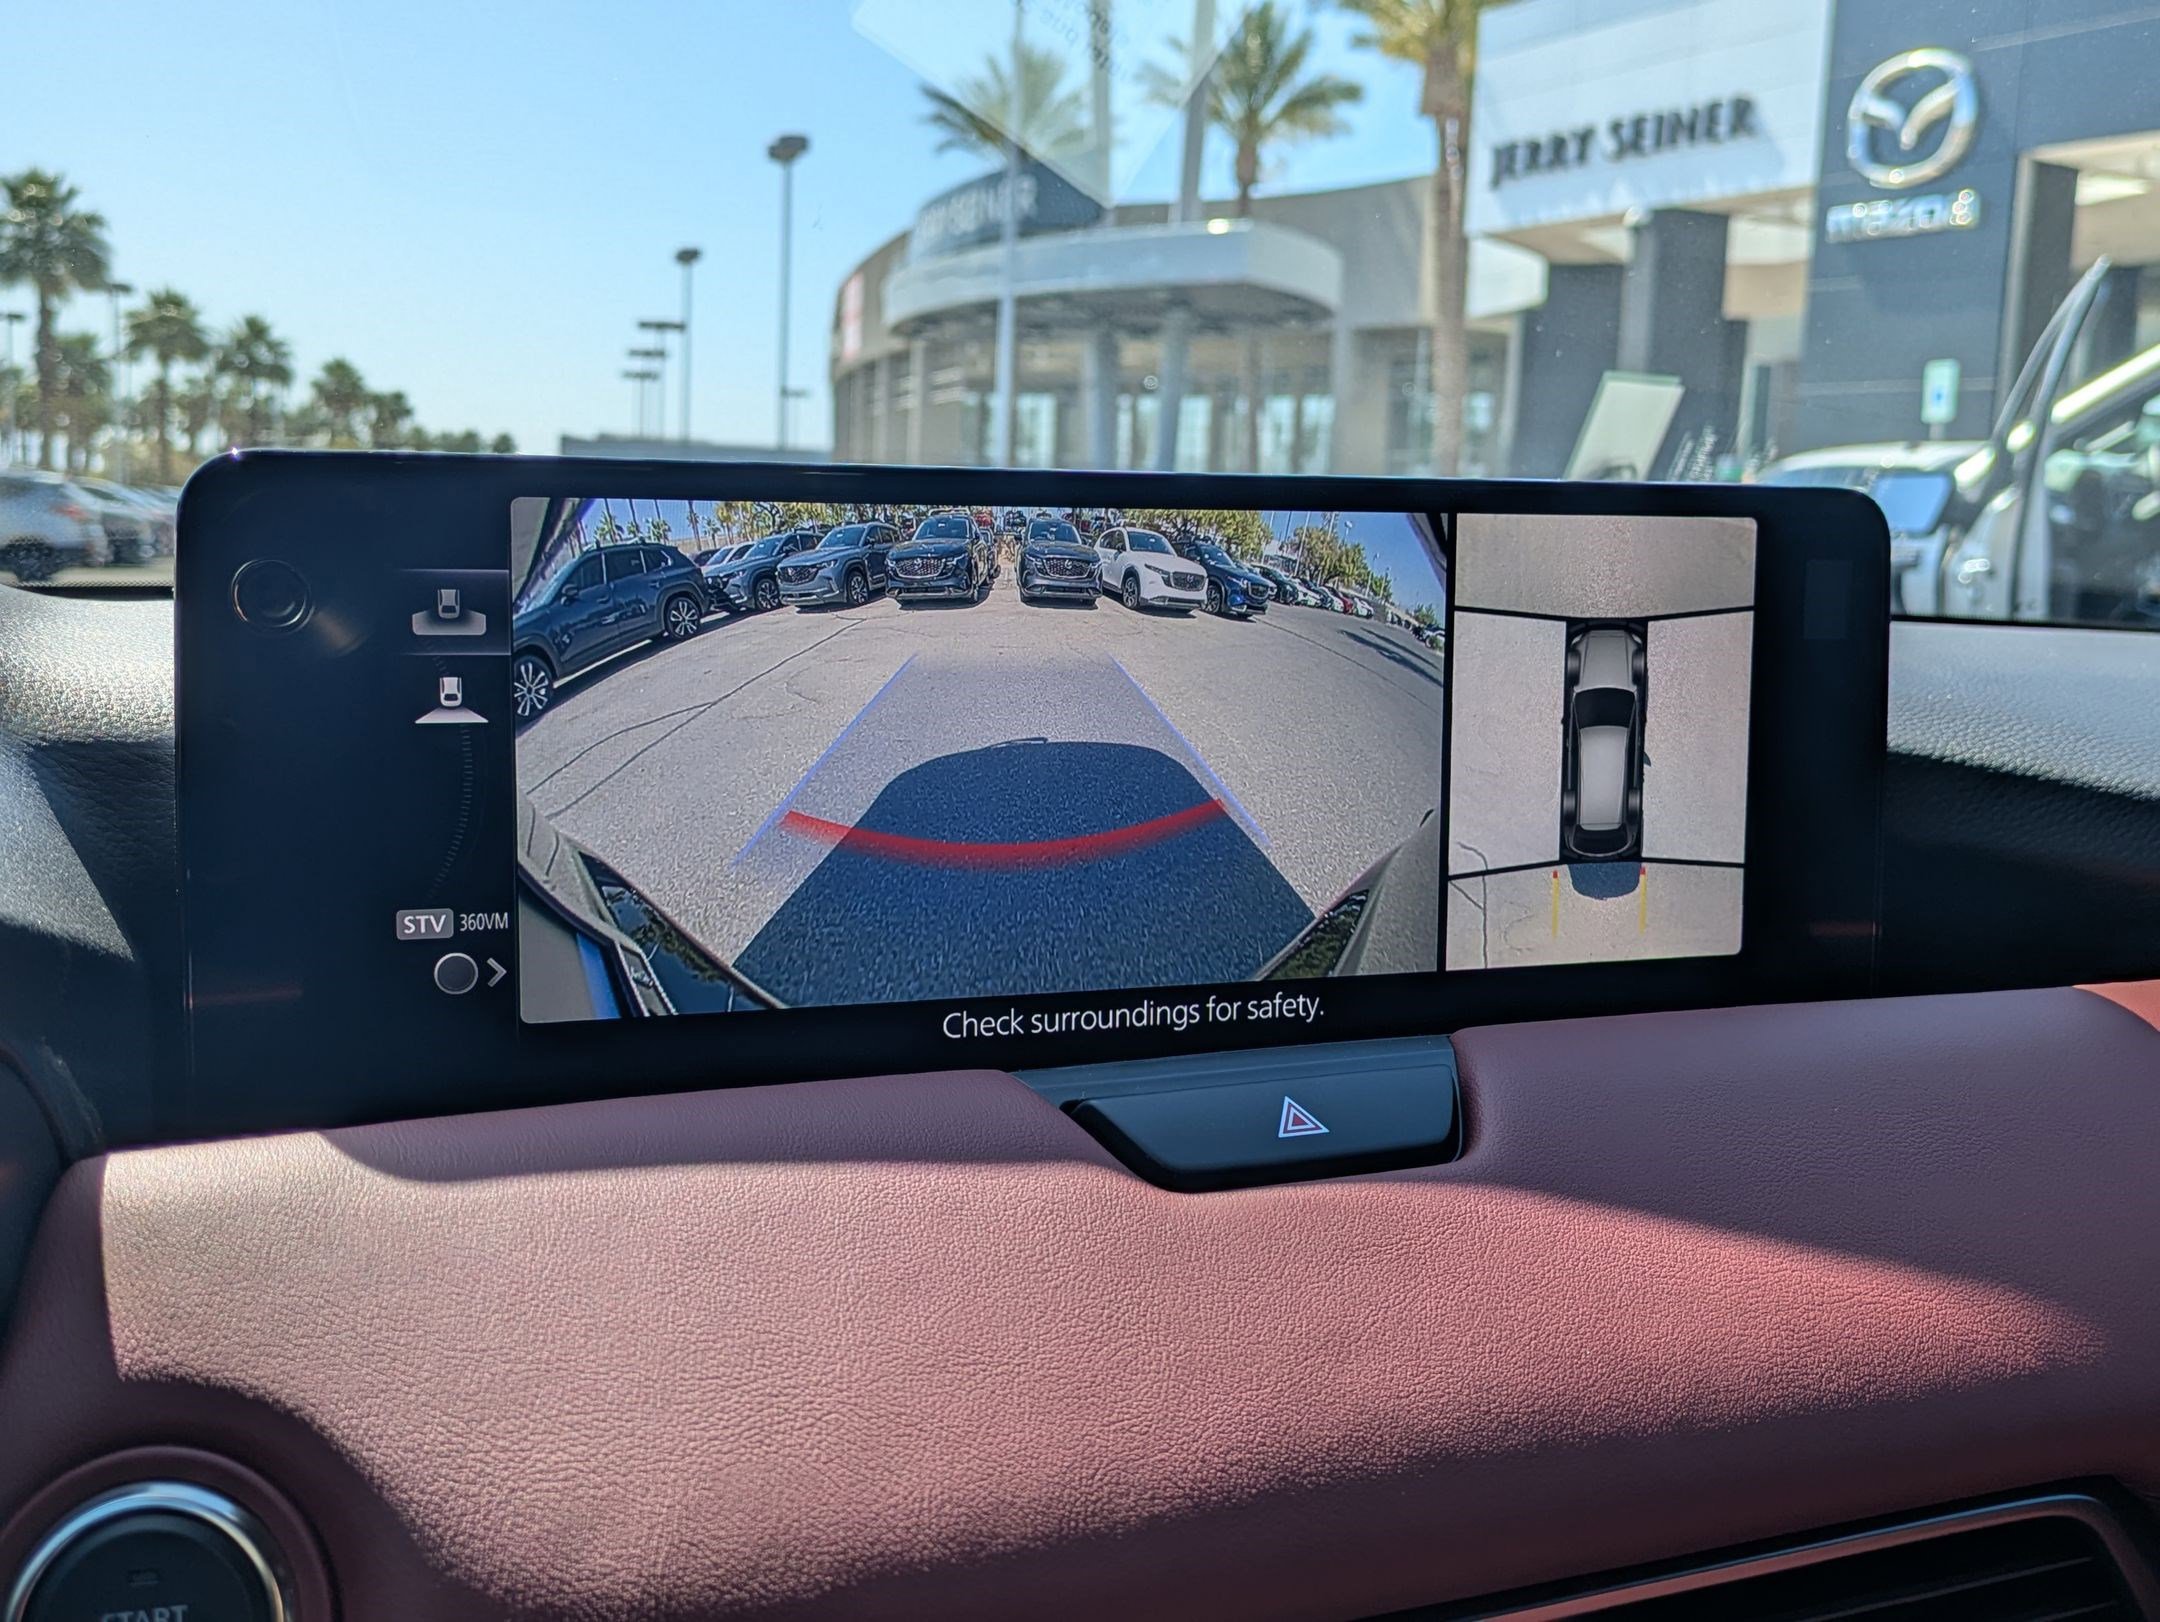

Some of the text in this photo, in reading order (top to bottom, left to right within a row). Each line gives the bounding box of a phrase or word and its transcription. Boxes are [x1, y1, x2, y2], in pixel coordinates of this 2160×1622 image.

[1490, 93, 1756, 189] JERRY SEINER
[403, 912, 508, 934] STV 360VM
[943, 991, 1324, 1039] Check surroundings for safety.
